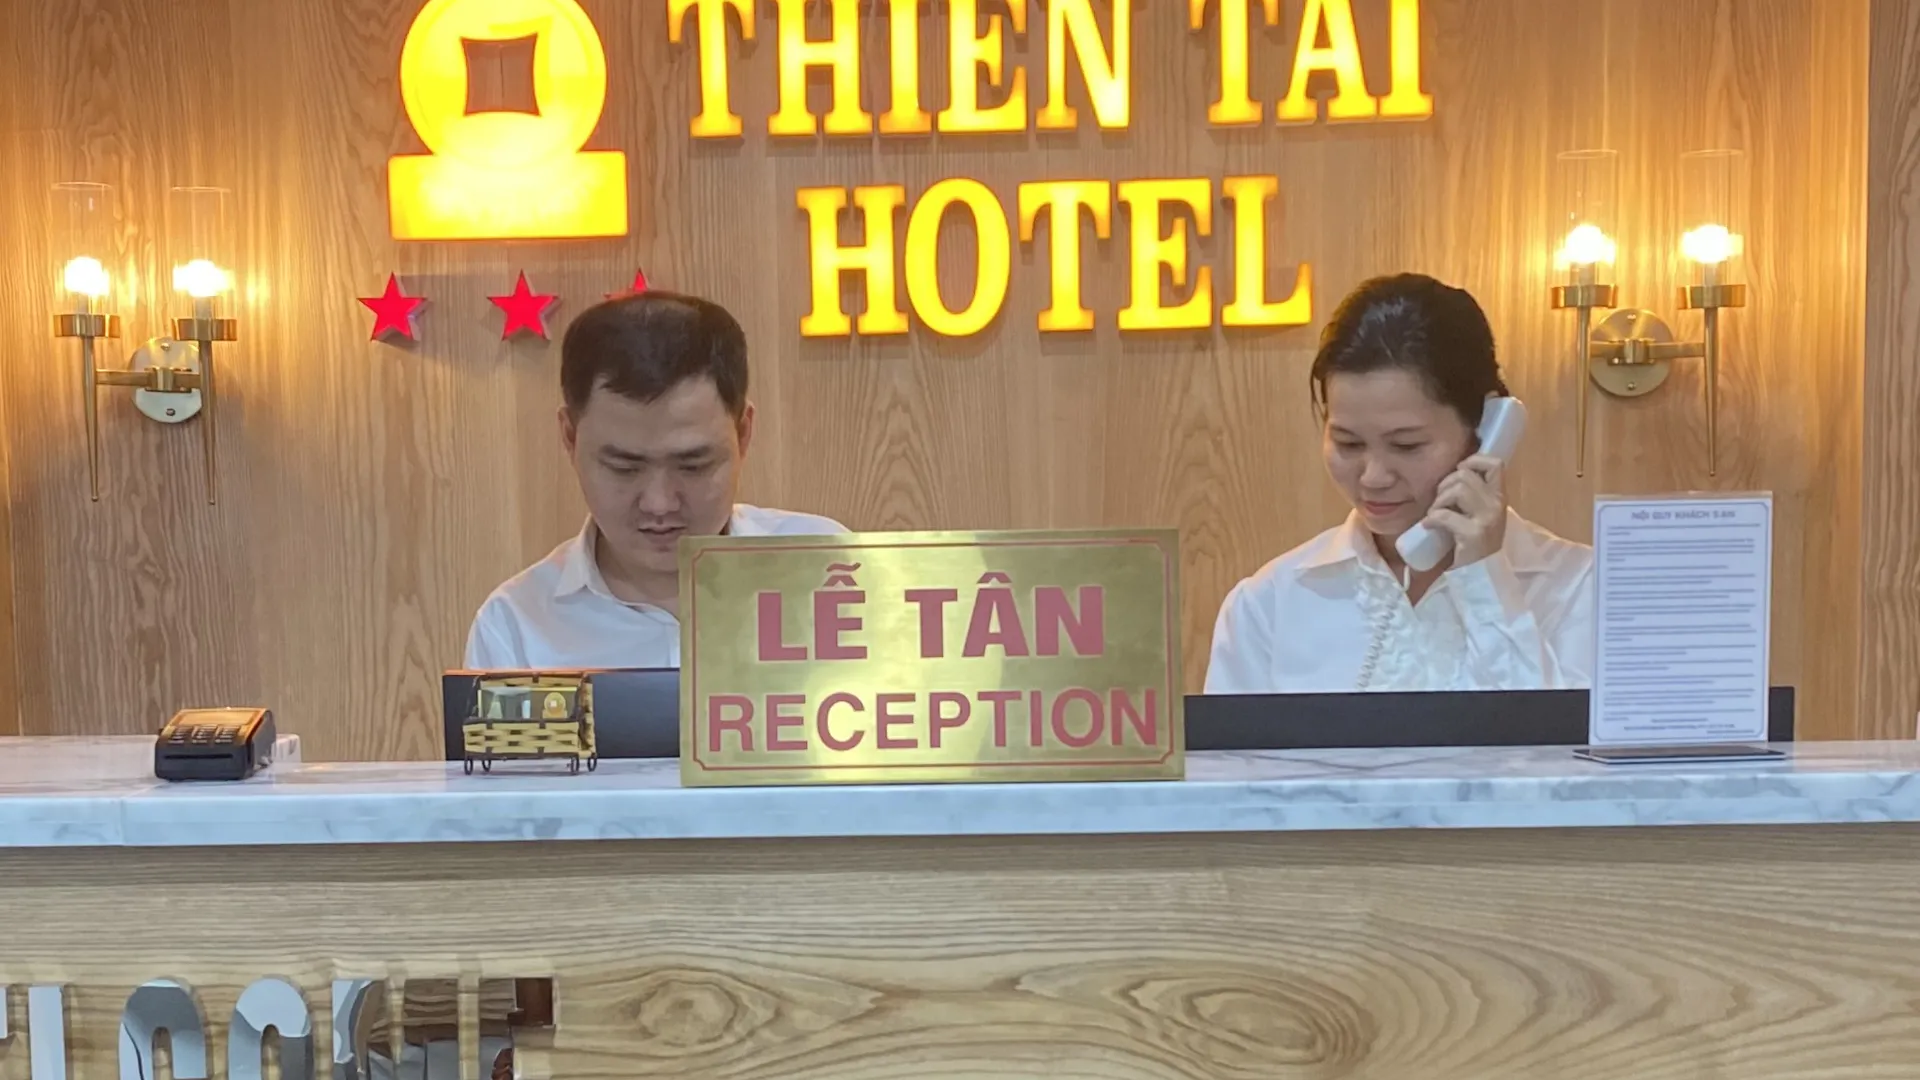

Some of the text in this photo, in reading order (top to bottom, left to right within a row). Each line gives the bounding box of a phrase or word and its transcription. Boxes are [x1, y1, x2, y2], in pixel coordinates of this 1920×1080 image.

[797, 176, 1312, 336] HOTEL
[757, 562, 1105, 661] LỄ TÂN
[708, 688, 1157, 752] RECEPTION
